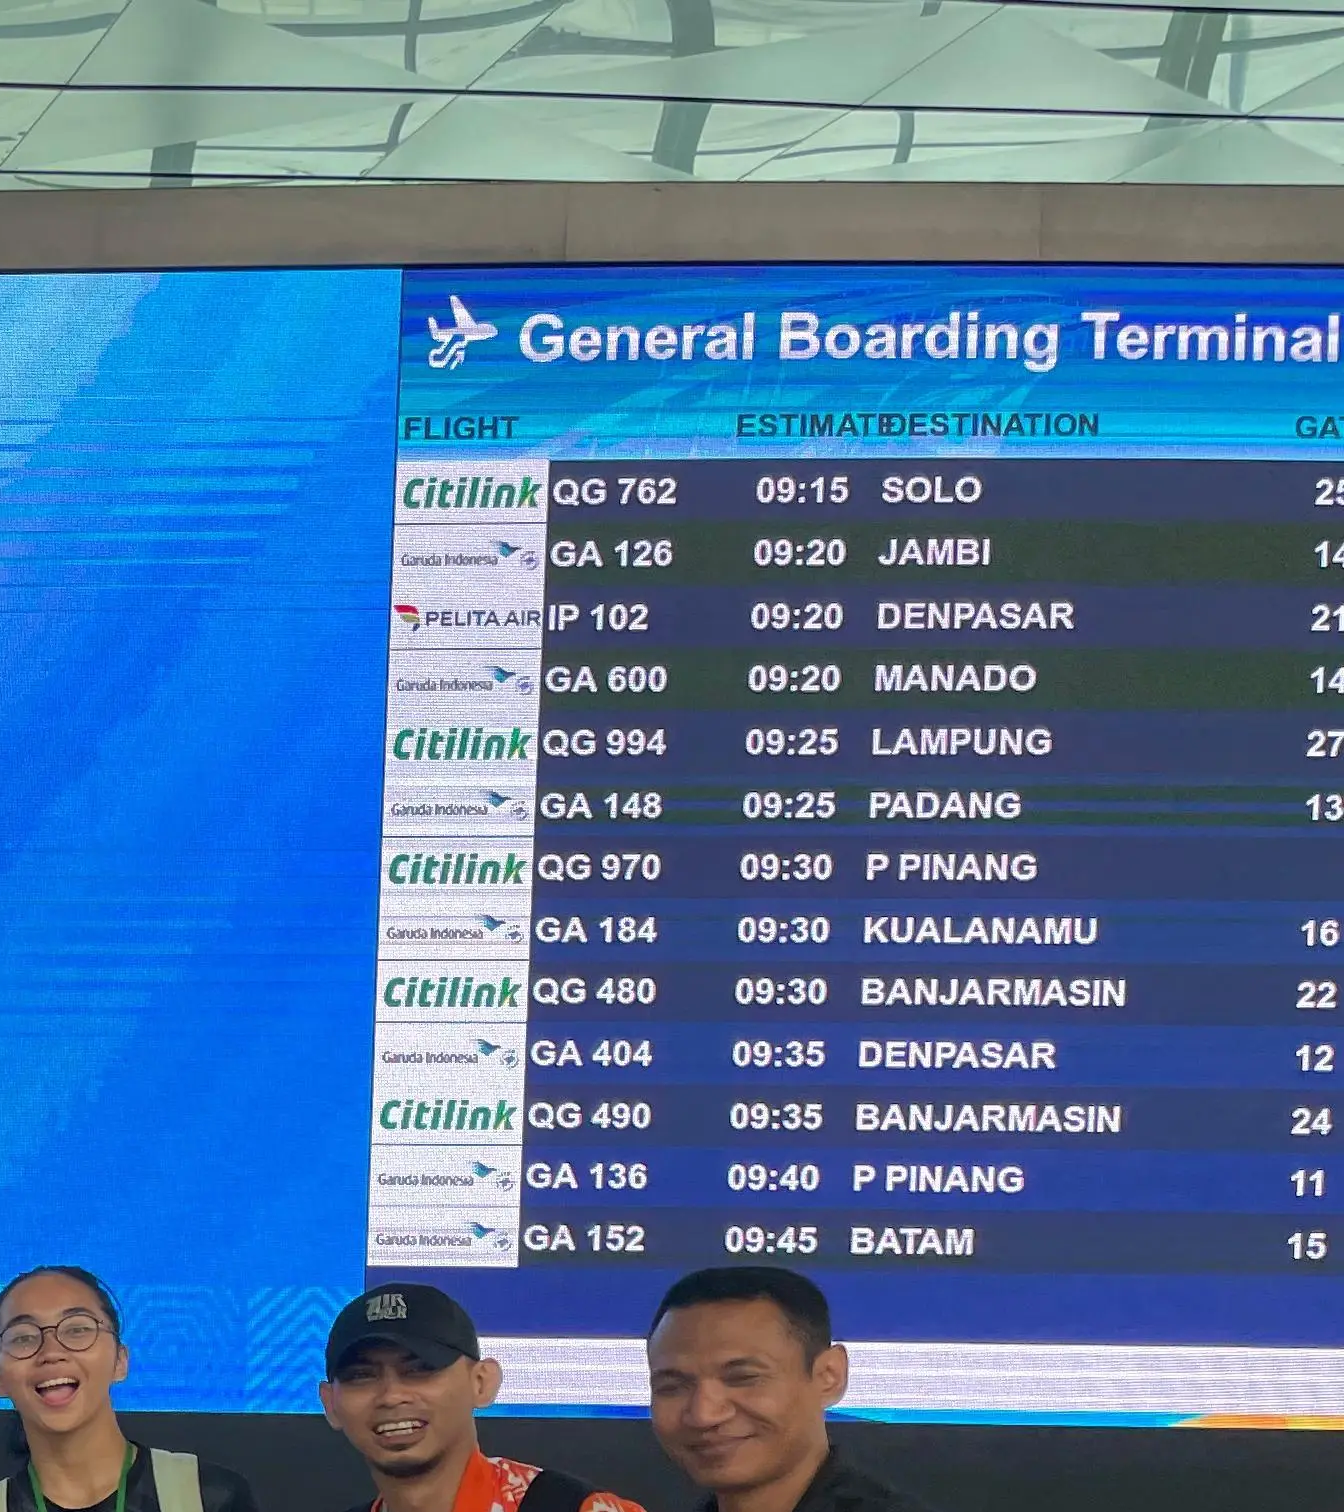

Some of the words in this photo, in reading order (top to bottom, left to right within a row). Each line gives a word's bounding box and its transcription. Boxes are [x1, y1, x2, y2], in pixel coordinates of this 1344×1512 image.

[518, 310, 756, 364] General
[779, 310, 1060, 374] Boarding
[1081, 310, 1341, 363] Terminal
[403, 416, 520, 440] FLIGHT
[880, 412, 1100, 438] DESTINATION
[403, 475, 542, 509] Citilink
[552, 478, 607, 506] QG
[618, 477, 677, 505] 762
[756, 476, 849, 504] 09:15
[882, 475, 982, 503] SOLO
[401, 554, 441, 567] Garuda
[444, 553, 499, 567] Indonesia
[550, 540, 603, 567] GA
[614, 539, 673, 567] 126
[754, 538, 847, 566] 09:20
[878, 538, 991, 566] JAMBI
[1314, 540, 1344, 568] 14
[425, 610, 497, 627] PELITA
[503, 610, 542, 627] AIR
[548, 604, 580, 631] IP
[590, 603, 649, 631] 102
[751, 602, 844, 630] 09:20
[877, 602, 1074, 630] DENPASAR
[1311, 604, 1344, 632] 21
[396, 678, 437, 691] Garuda
[439, 678, 494, 691] Indonesia
[545, 666, 598, 693] GA
[608, 665, 668, 693] 600
[748, 664, 841, 692] 09:20
[874, 664, 1037, 692] MANADO
[1310, 666, 1344, 694] 14
[392, 727, 533, 760] Citilink
[542, 729, 596, 757] QG
[606, 728, 667, 755] 994
[745, 728, 839, 755] 09:25
[872, 728, 1052, 756] LAMPUNG
[1306, 730, 1344, 758] 27
[391, 803, 432, 816] Garuda
[434, 803, 488, 816] Indonesia
[540, 792, 593, 819] GA
[604, 792, 662, 819] 148
[742, 791, 836, 819] 09:25
[869, 791, 1022, 819] PADANG
[1306, 793, 1344, 821] 13
[388, 853, 528, 885] Citilink
[537, 853, 591, 882] QG
[601, 853, 661, 881] 970
[740, 853, 833, 881] 09:30
[866, 853, 890, 881] P
[899, 853, 1037, 881] PINANG
[386, 926, 428, 939] Garuda
[430, 927, 484, 939] Indonesia
[535, 916, 588, 943] GA
[599, 916, 658, 943] 184
[737, 916, 830, 944] 09:30
[864, 916, 1098, 945] KUALANAMU
[1301, 919, 1339, 947] 16
[383, 976, 522, 1008] Citilink
[532, 977, 586, 1005] QG
[596, 977, 656, 1004] 480
[735, 977, 828, 1005] 09:30
[861, 978, 1126, 1007] BANJARMASIN
[1296, 981, 1337, 1009] 22
[382, 1051, 423, 1064] Garuda
[425, 1052, 479, 1064] Indonesia
[530, 1039, 583, 1067] GA
[592, 1040, 653, 1067] 404
[732, 1040, 826, 1067] 09:35
[858, 1040, 1056, 1069] DENPASAR
[1295, 1044, 1335, 1072] 12
[379, 1099, 517, 1131] Citilink
[528, 1102, 582, 1130] QG
[591, 1102, 651, 1129] 490
[730, 1102, 823, 1130] 09:35
[856, 1103, 1121, 1133] BANJARMASIN
[1291, 1107, 1332, 1135] 24
[378, 1174, 419, 1187] Garuda
[421, 1175, 474, 1187] Indonesia
[526, 1162, 579, 1189] GA
[589, 1162, 647, 1189] 136
[727, 1163, 820, 1191] 09:40
[853, 1164, 876, 1192] P
[886, 1164, 1025, 1193] PINANG
[1290, 1169, 1324, 1197] 11
[376, 1234, 417, 1247] Garuda
[419, 1234, 472, 1247] Indonesia
[523, 1224, 576, 1251] GA
[587, 1224, 645, 1252] 152
[725, 1225, 818, 1254] 09:45
[850, 1227, 974, 1256] BATAM
[1287, 1232, 1327, 1260] 15
